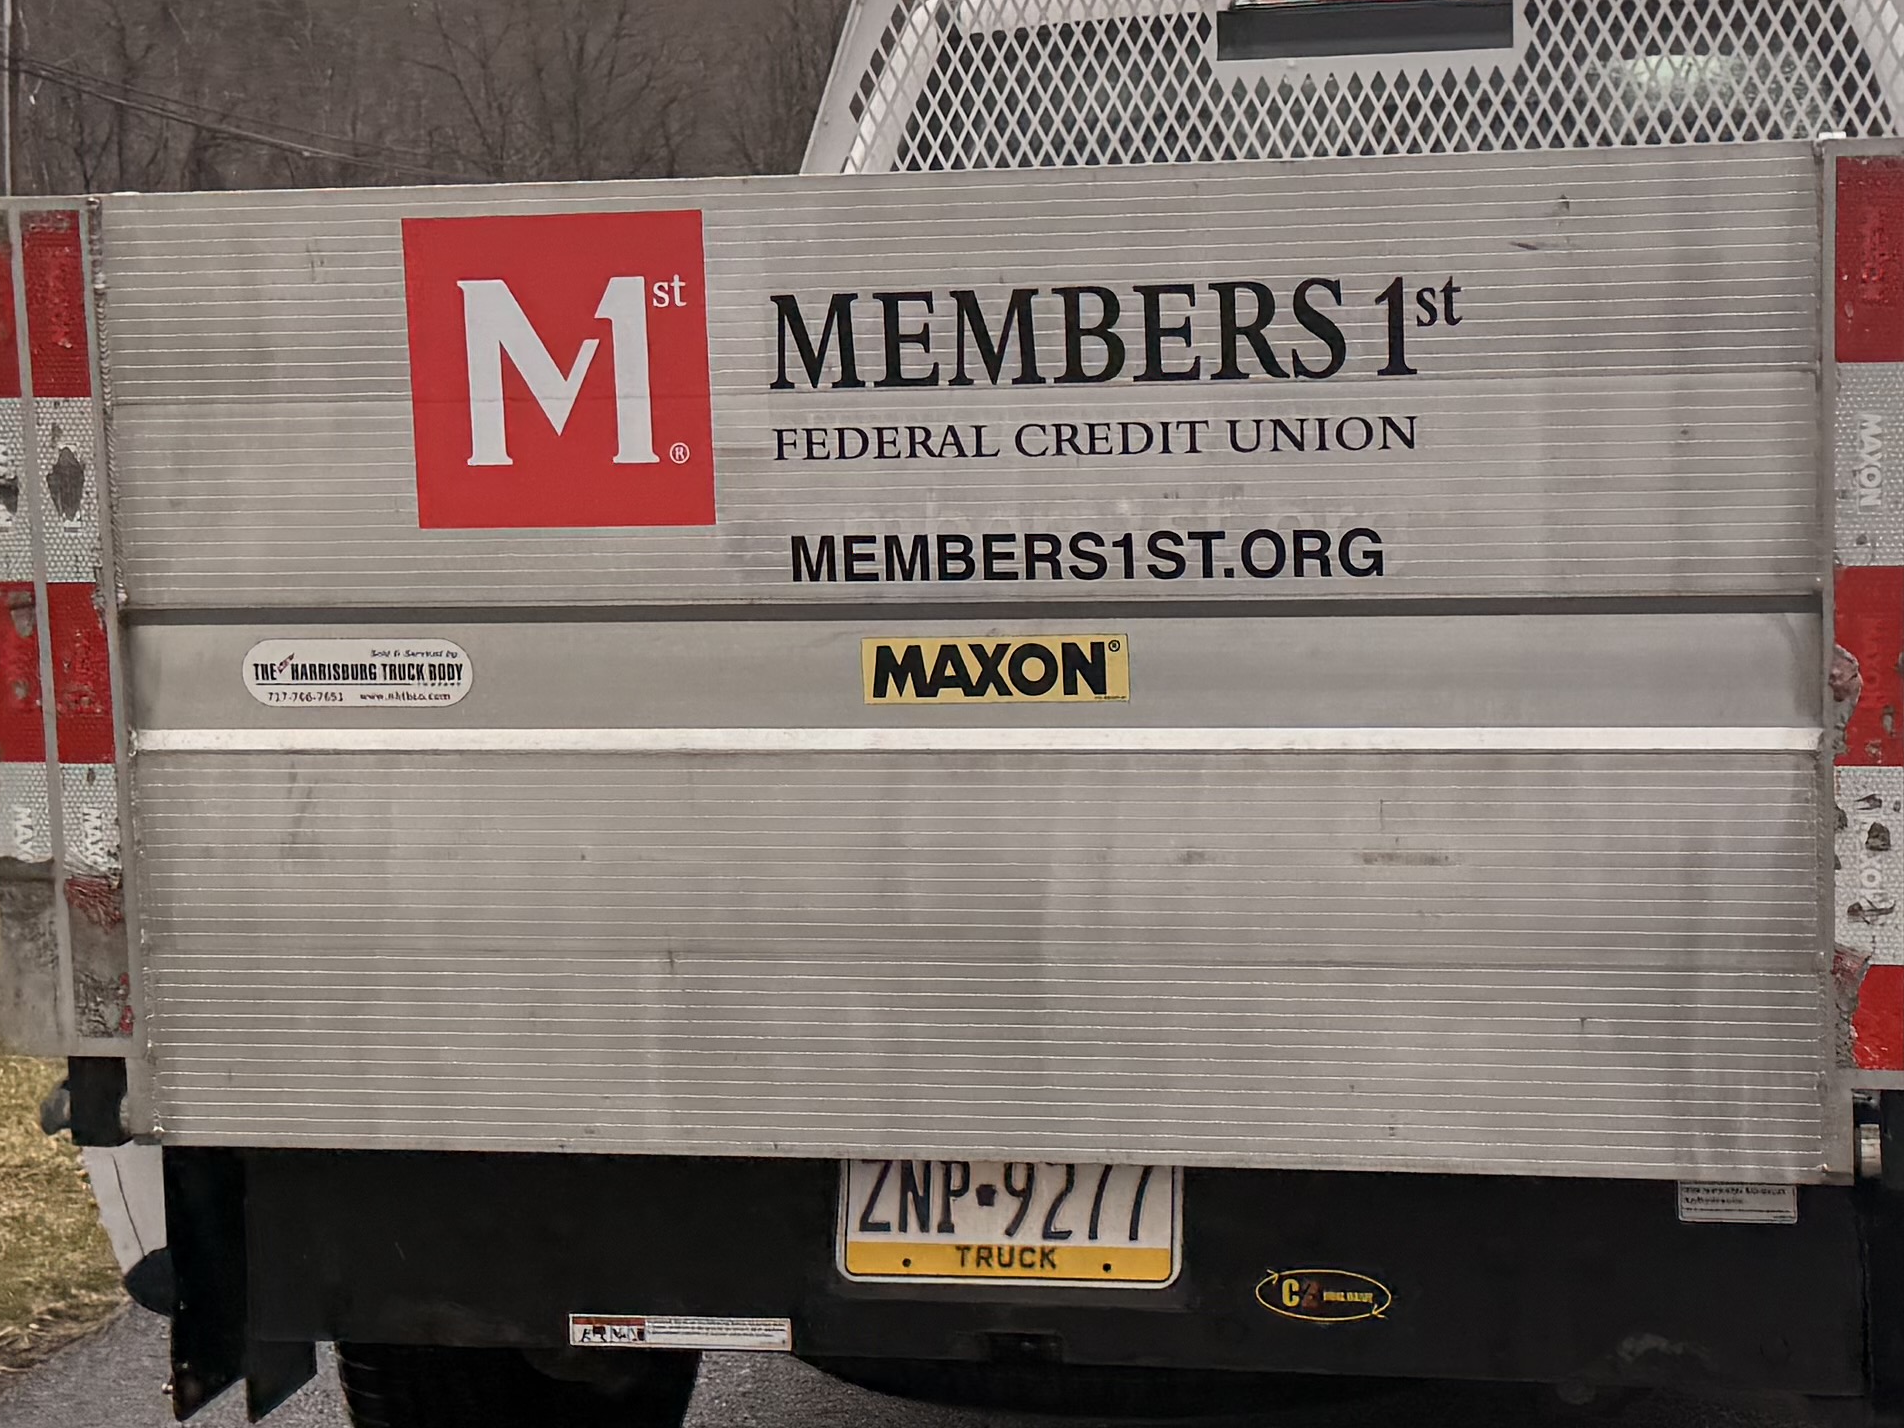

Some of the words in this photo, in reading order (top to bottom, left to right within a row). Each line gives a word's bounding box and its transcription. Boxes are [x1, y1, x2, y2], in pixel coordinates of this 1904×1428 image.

[769, 277, 1348, 390] MEMBERS
[1375, 275, 1463, 377] 1st
[773, 424, 999, 461] FEDERAL
[1014, 419, 1209, 456] CREDIT
[1227, 415, 1418, 453] UNION
[1858, 413, 1882, 506] MAXON
[791, 527, 1384, 583] MEMBERS1ST.ORG
[253, 663, 278, 681] THE
[291, 663, 376, 681] HARRISBURG
[381, 663, 425, 682] TRUCK
[428, 663, 463, 681] BODY
[872, 641, 1108, 698] MAXON
[955, 1244, 1058, 1270] TRUCK
